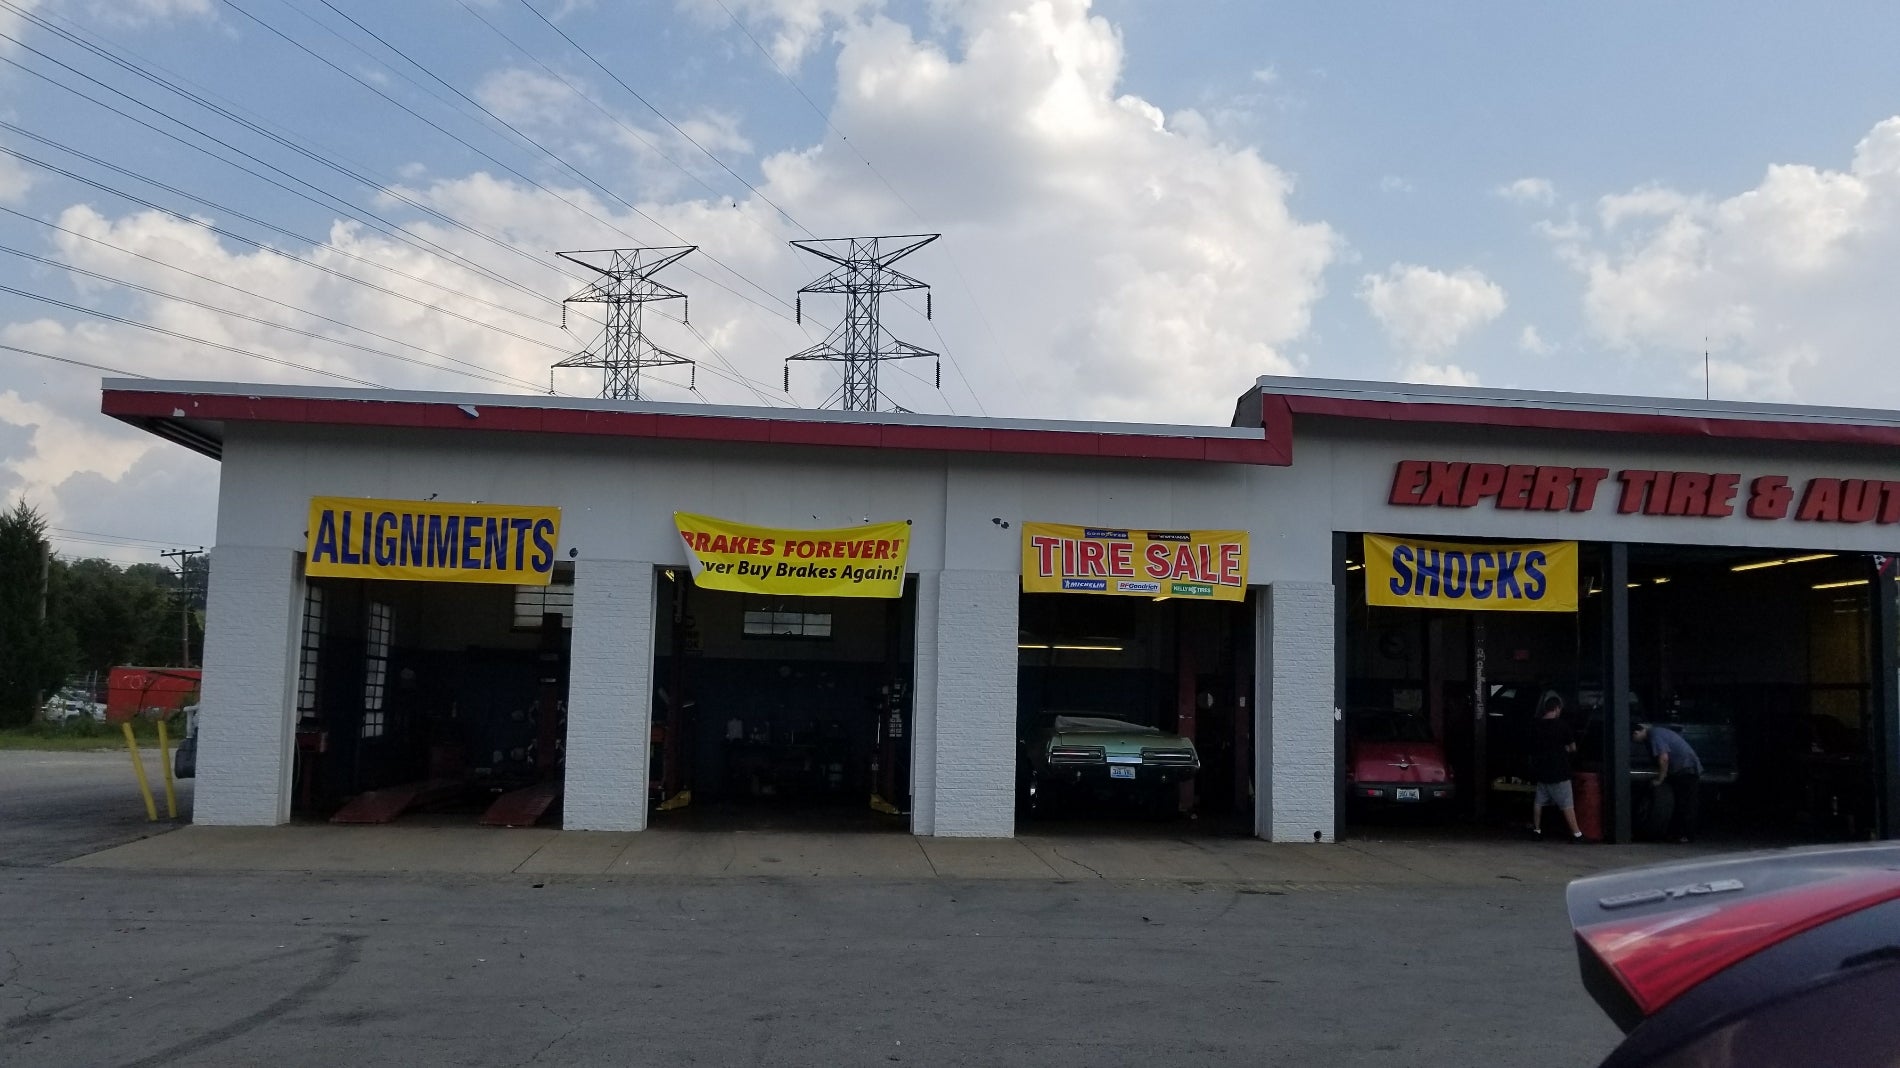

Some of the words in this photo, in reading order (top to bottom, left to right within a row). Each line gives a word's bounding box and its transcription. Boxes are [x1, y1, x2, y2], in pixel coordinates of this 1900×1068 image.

[1388, 460, 1609, 511] EXPERT
[1617, 470, 1741, 518] TIRE
[1747, 475, 1793, 520] &
[1796, 477, 1900, 523] AUT
[312, 510, 555, 573] ALIGNMENTS
[783, 539, 899, 560] FOREVER!
[1032, 535, 1134, 577] TIRE
[1145, 542, 1242, 587] SALE
[738, 560, 772, 580] Buy
[776, 562, 837, 579] Brakes
[841, 564, 899, 584] Again!
[1389, 545, 1547, 600] SHOCKS
